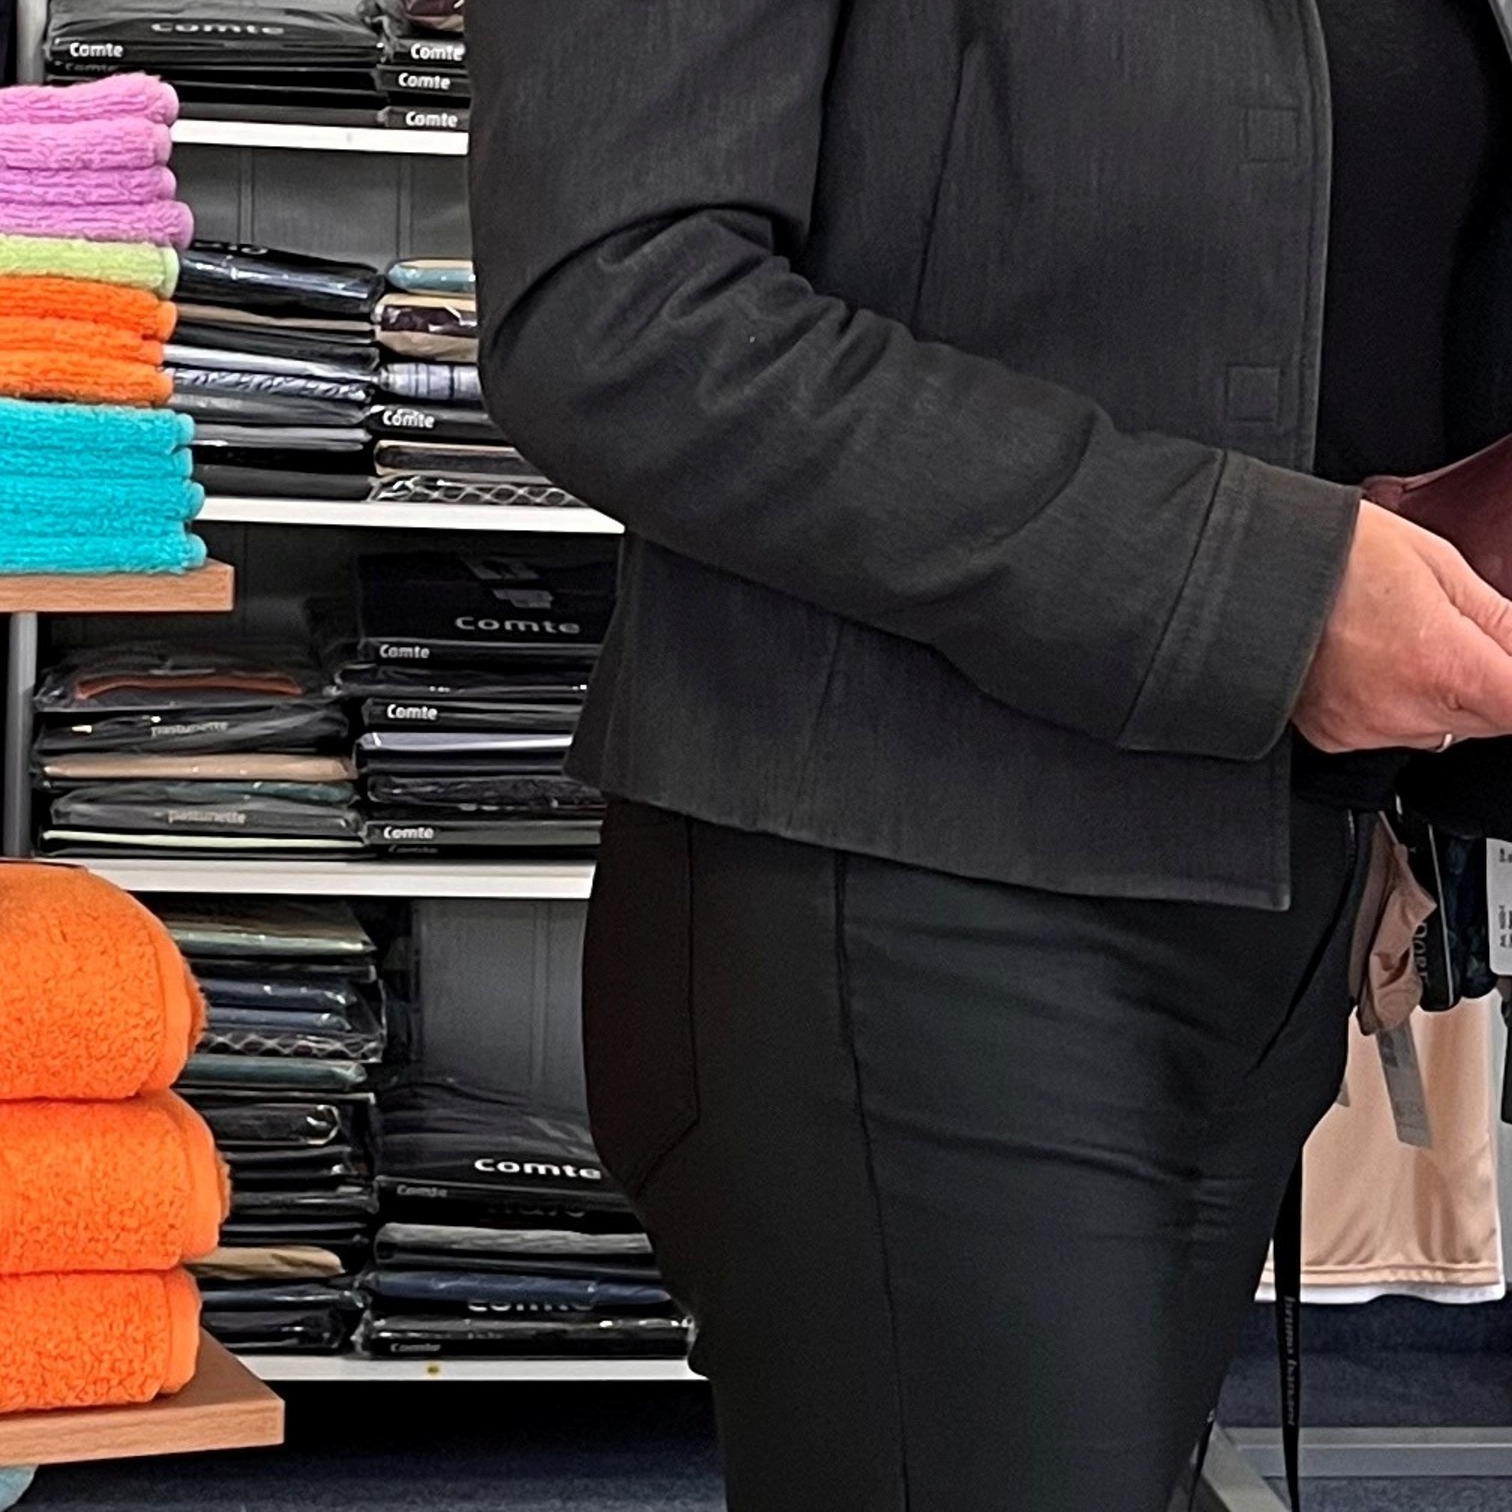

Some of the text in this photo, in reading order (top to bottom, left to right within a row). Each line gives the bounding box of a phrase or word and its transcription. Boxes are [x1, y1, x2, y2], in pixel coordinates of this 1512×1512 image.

[69, 42, 124, 59] Comte
[410, 42, 465, 62] Comte
[398, 72, 450, 90] Comte
[405, 110, 458, 128] Comte
[454, 615, 581, 635] Comte
[379, 643, 430, 659] Comte
[387, 704, 438, 720] Comte
[383, 825, 435, 839] Comte
[473, 1158, 602, 1180] Comte
